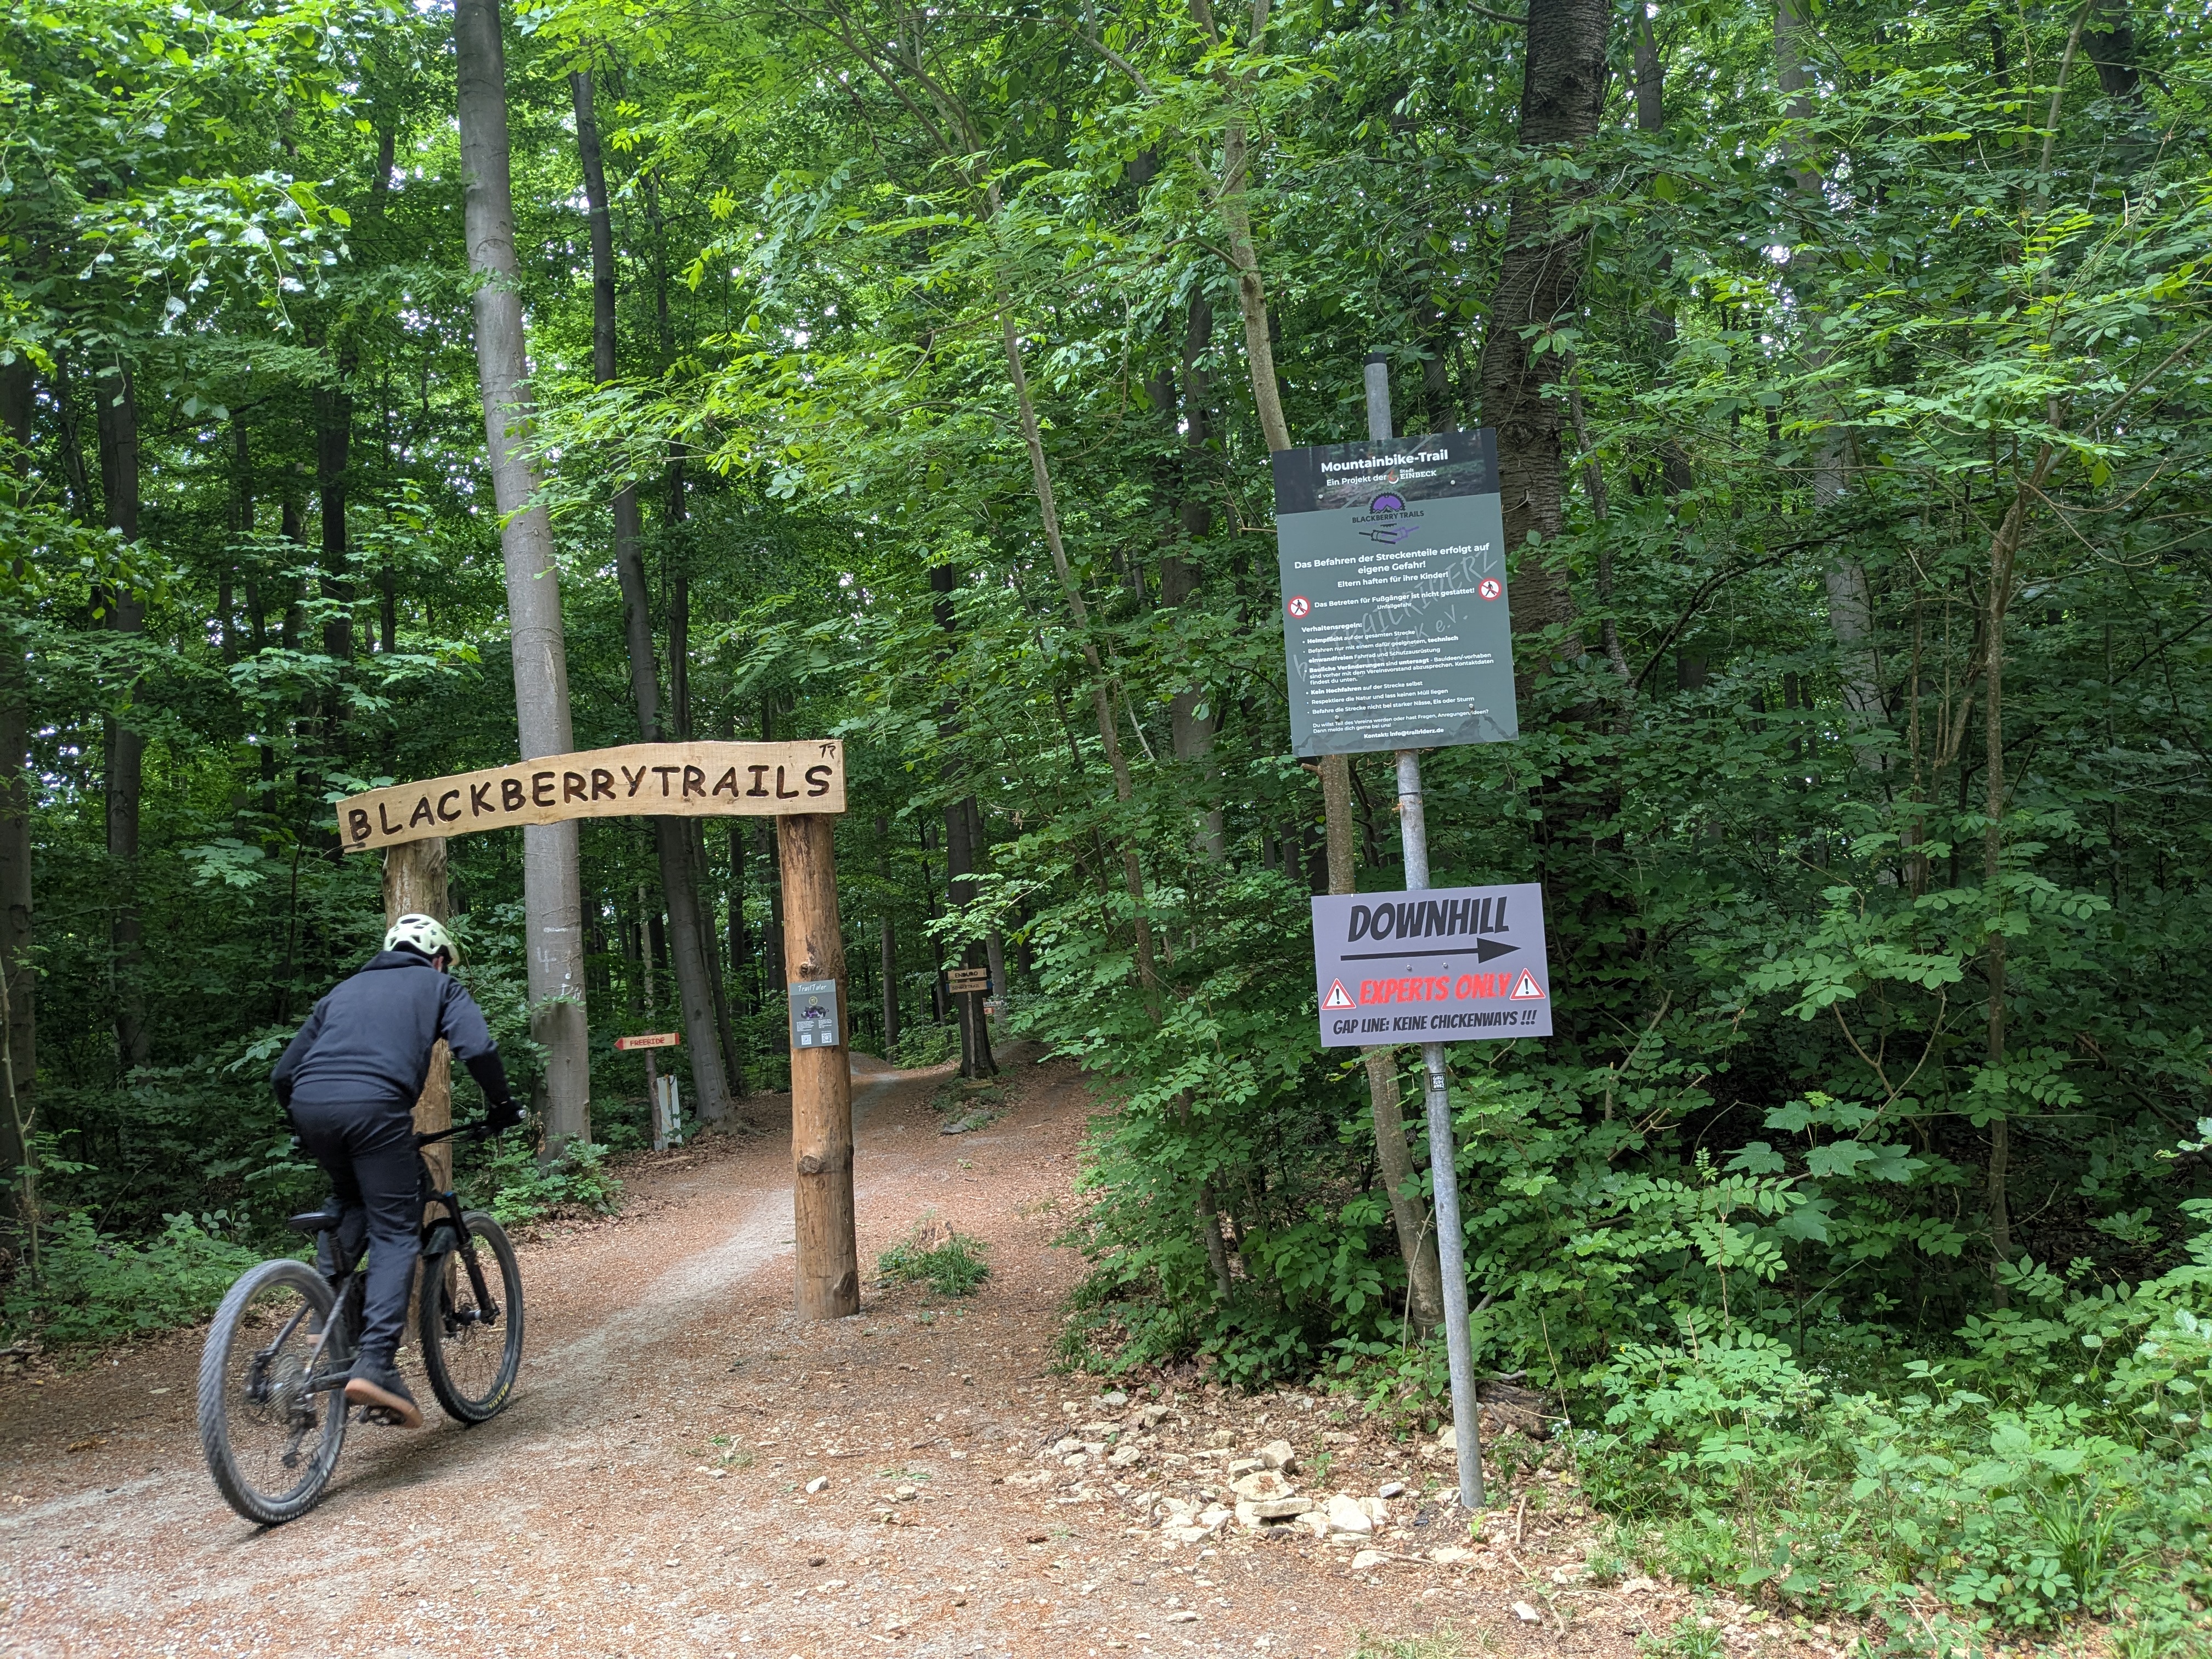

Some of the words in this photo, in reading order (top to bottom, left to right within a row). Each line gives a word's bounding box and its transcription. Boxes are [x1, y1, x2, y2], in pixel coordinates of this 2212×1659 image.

[1321, 448, 1448, 473] Mountainbike-Trail
[1326, 478, 1340, 486] Ein
[1341, 475, 1372, 485] Projekt
[1399, 469, 1437, 479] EINBECK
[1351, 512, 1398, 523] BLACKBERRY
[1398, 510, 1424, 518] TRAILS
[1294, 561, 1312, 569] Das
[1313, 557, 1356, 567] Befahren
[1357, 554, 1374, 563] der
[1375, 548, 1438, 561] Streckenteile
[1439, 545, 1472, 555] erfolgt
[1473, 542, 1489, 552] auf
[1357, 565, 1390, 575] eigene
[1391, 560, 1426, 571] Gefahr!
[1362, 577, 1388, 585] haften
[1419, 571, 1448, 580] Kinder!
[1328, 599, 1359, 607] Betreten
[1371, 594, 1410, 603] Fußgänger
[1440, 587, 1475, 597] gestattet!
[1301, 622, 1363, 633] Verhaltensregeln:
[1427, 635, 1459, 643] technisch
[1308, 654, 1353, 663] einwandfreien
[1389, 647, 1441, 656] Schutzausrüstung
[1336, 662, 1385, 670] Veränderungen
[1398, 657, 1430, 665] untersagt
[1365, 665, 1412, 674] Vereinsvorstand
[1412, 662, 1454, 670] abzusprechen.
[1325, 686, 1362, 694] Hochfahren
[1311, 697, 1345, 705] Respektiere
[1347, 896, 1510, 943] DOWNHILL
[1359, 975, 1451, 1006] EXPERTS
[1454, 972, 1513, 1000] ONLY
[1333, 1018, 1358, 1035] GAP
[1361, 1017, 1390, 1033] LINE:
[1393, 1015, 1428, 1032] KEINE
[1430, 1011, 1518, 1030] CHICKENWAYS
[1520, 1009, 1538, 1025] !!!
[630, 1037, 665, 1047] FREERIDE
